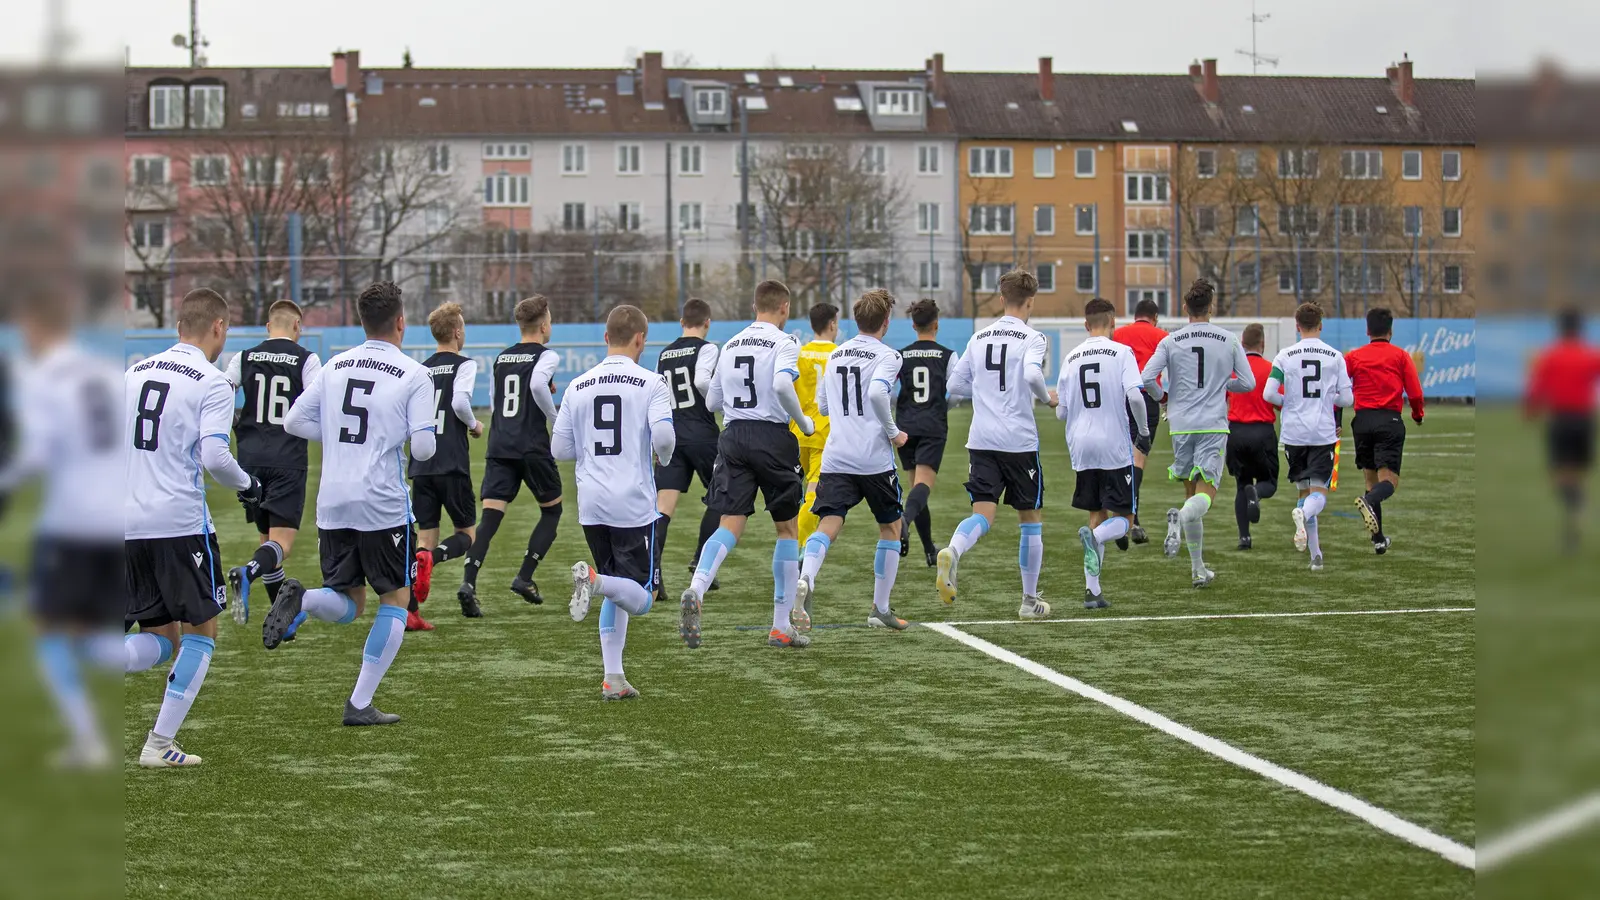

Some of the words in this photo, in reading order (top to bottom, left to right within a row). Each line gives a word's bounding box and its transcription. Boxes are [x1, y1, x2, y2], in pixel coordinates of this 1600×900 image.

[741, 336, 776, 349] MÜNCHEN
[976, 330, 991, 341] 1860
[992, 329, 1028, 340] MÜNCHEN
[1082, 347, 1118, 358] MÜNCHEN
[1174, 333, 1190, 343] 1860
[1191, 330, 1227, 343] MÜNCHEN
[1303, 346, 1337, 358] MÜNCHEN
[133, 360, 155, 373] 1860
[155, 360, 206, 382] MÜNCHEN
[334, 358, 355, 371] 1860
[356, 357, 406, 379] MÜNCHEN
[575, 377, 596, 392] 1860
[598, 372, 647, 388] MÜNCHEN
[663, 366, 696, 410] 13
[733, 355, 758, 409] 3
[912, 366, 930, 404] 9
[985, 343, 1008, 392] 4
[1079, 362, 1102, 409] 6
[1191, 346, 1205, 389] 1
[1301, 359, 1322, 399] 2
[254, 372, 291, 426] 16
[338, 378, 376, 445] 5
[502, 374, 520, 418] 8
[836, 365, 864, 417] 11
[133, 379, 171, 452] 8
[593, 394, 623, 457] 9
